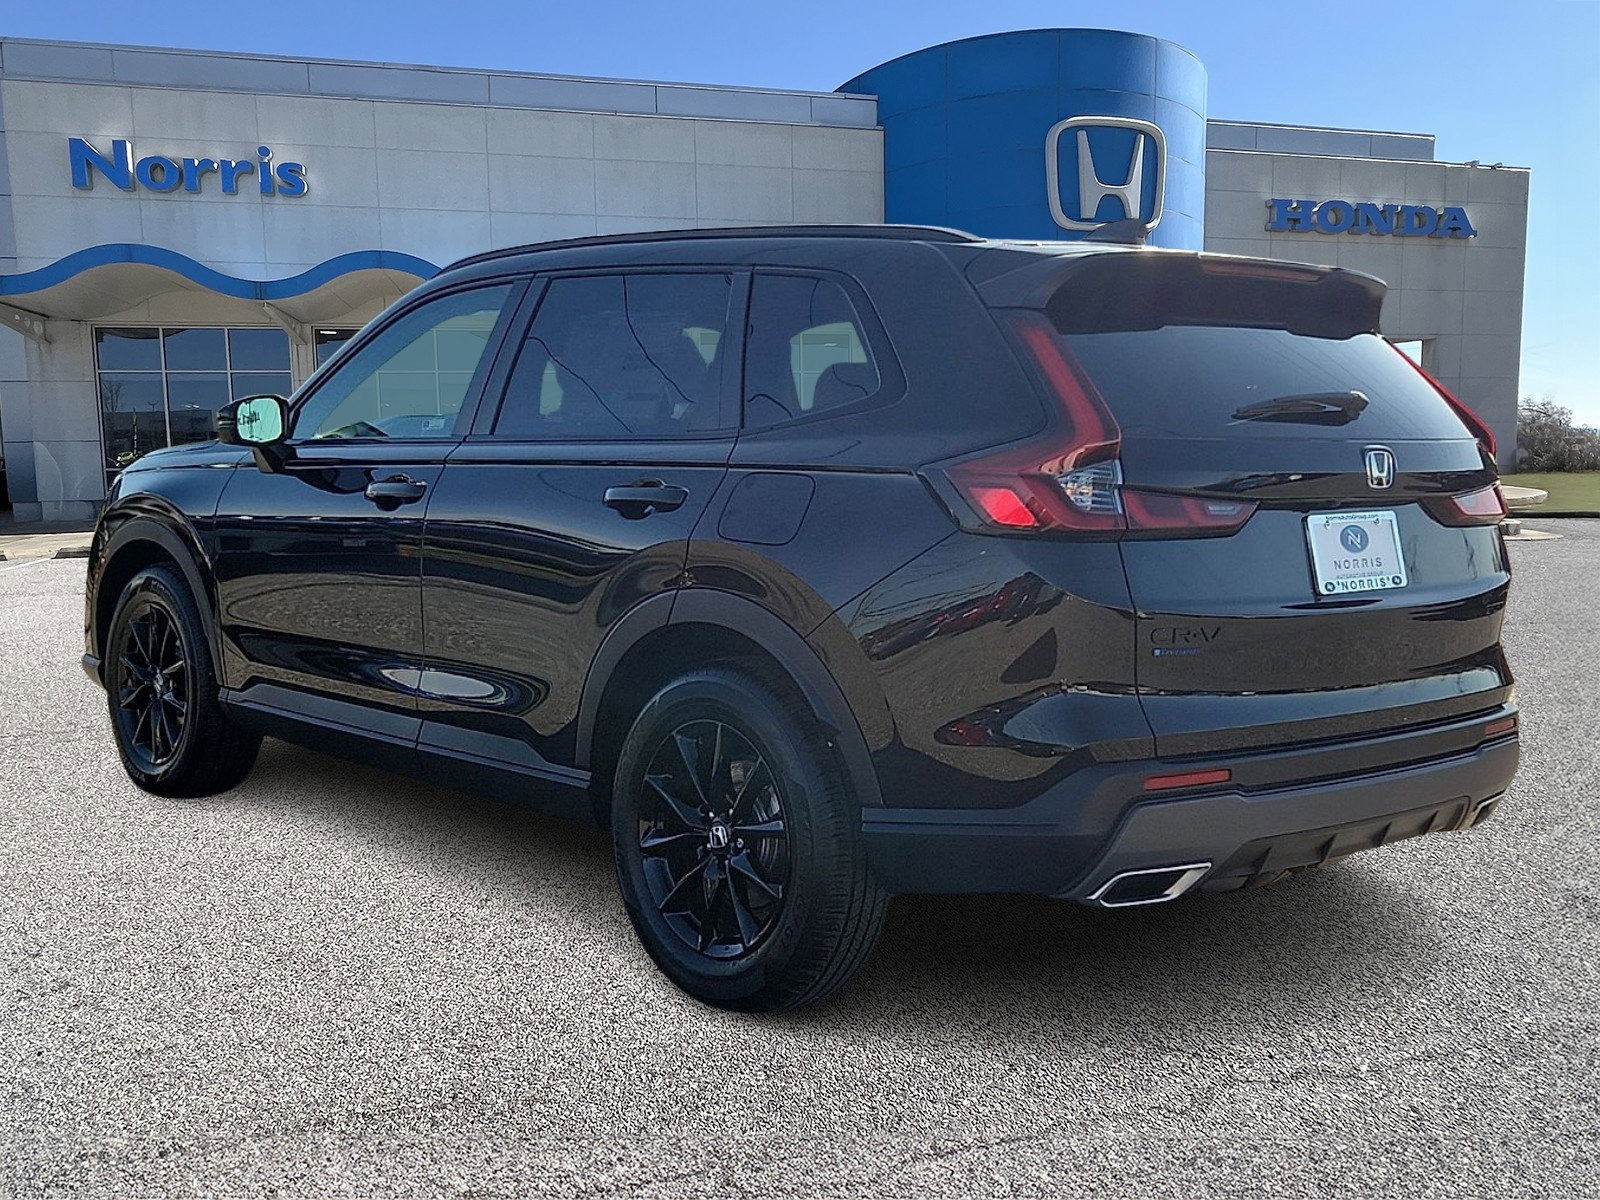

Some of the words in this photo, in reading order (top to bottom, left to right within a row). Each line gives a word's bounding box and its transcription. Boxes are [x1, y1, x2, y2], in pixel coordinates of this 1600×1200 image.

[68, 137, 308, 197] Norris
[1265, 198, 1478, 239] HONDA
[1333, 557, 1383, 570] NORRIS
